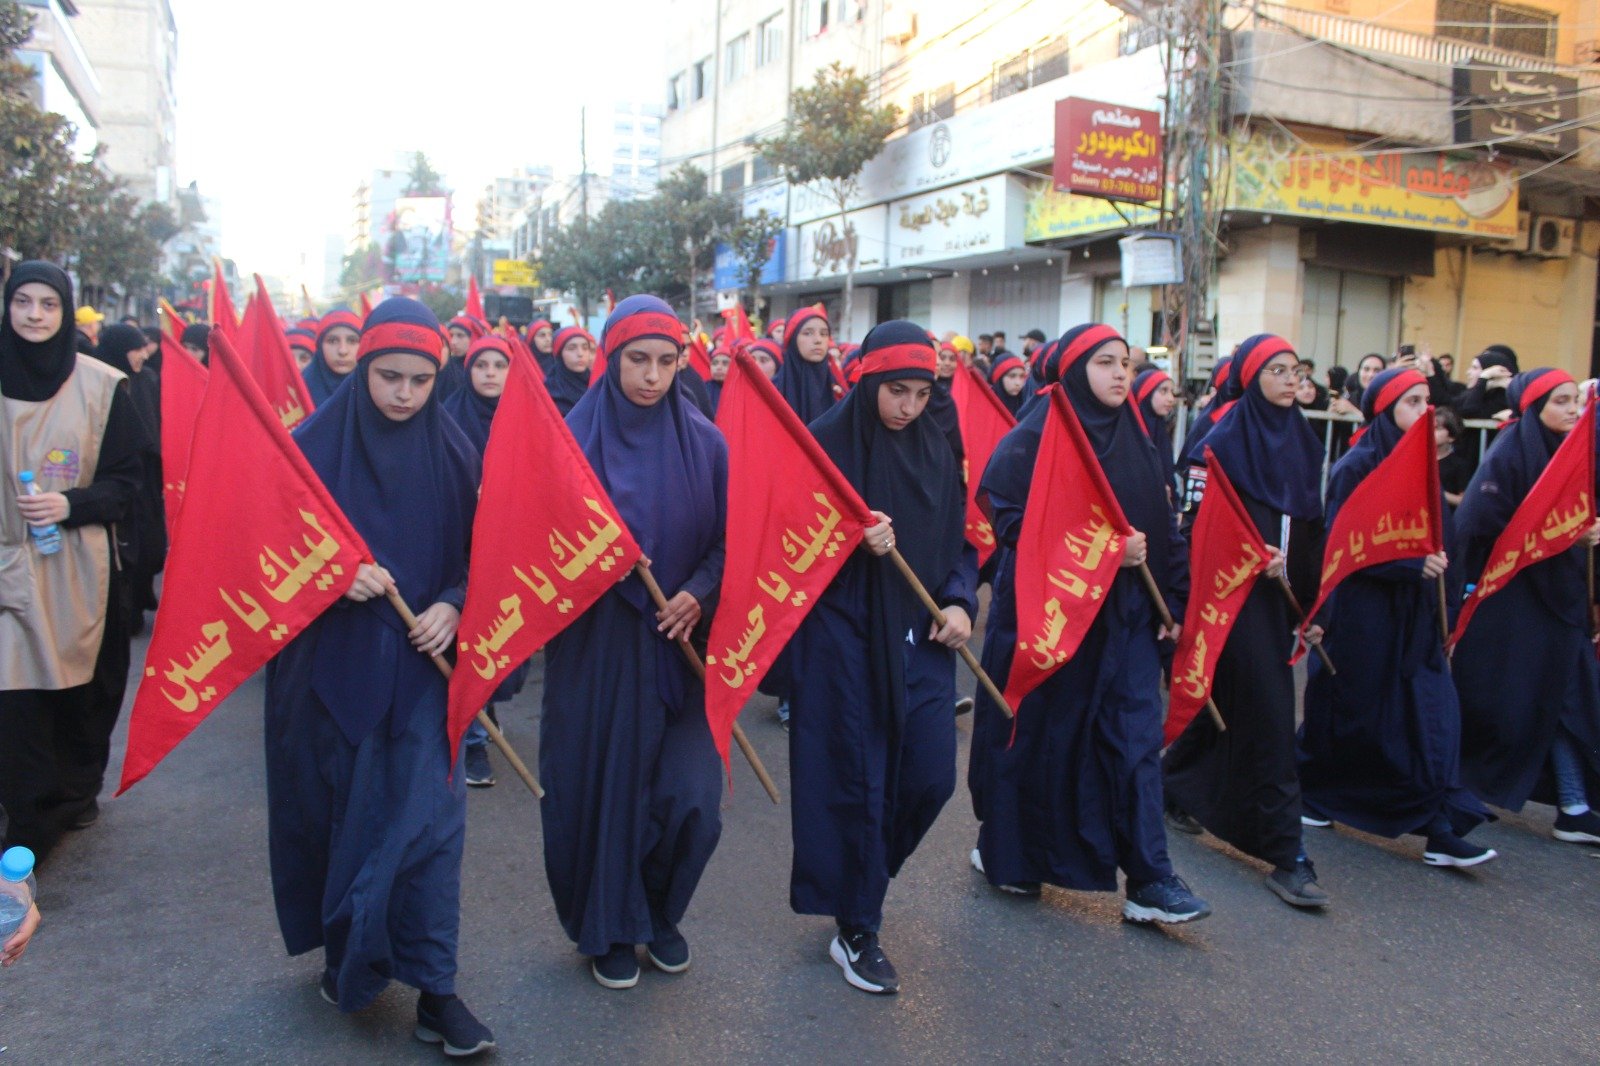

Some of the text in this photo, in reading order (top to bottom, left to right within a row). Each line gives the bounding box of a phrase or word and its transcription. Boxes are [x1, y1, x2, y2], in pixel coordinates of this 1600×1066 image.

[1092, 108, 1141, 129] مطعم
[1076, 130, 1156, 162] الكومودور
[1283, 151, 1470, 201] مطعم الكومودور
[1371, 507, 1428, 551] لبيك
[1541, 491, 1590, 540] لبيك
[1349, 528, 1367, 564] يا
[1525, 531, 1543, 559] يا
[145, 507, 344, 713] لبيك يا حسين
[460, 496, 625, 681] لبيك يا حسين
[706, 491, 847, 689] لبيك يا حسين
[1019, 502, 1120, 671] لبيك يا حسين
[1174, 542, 1262, 699] لبيك يا حسين
